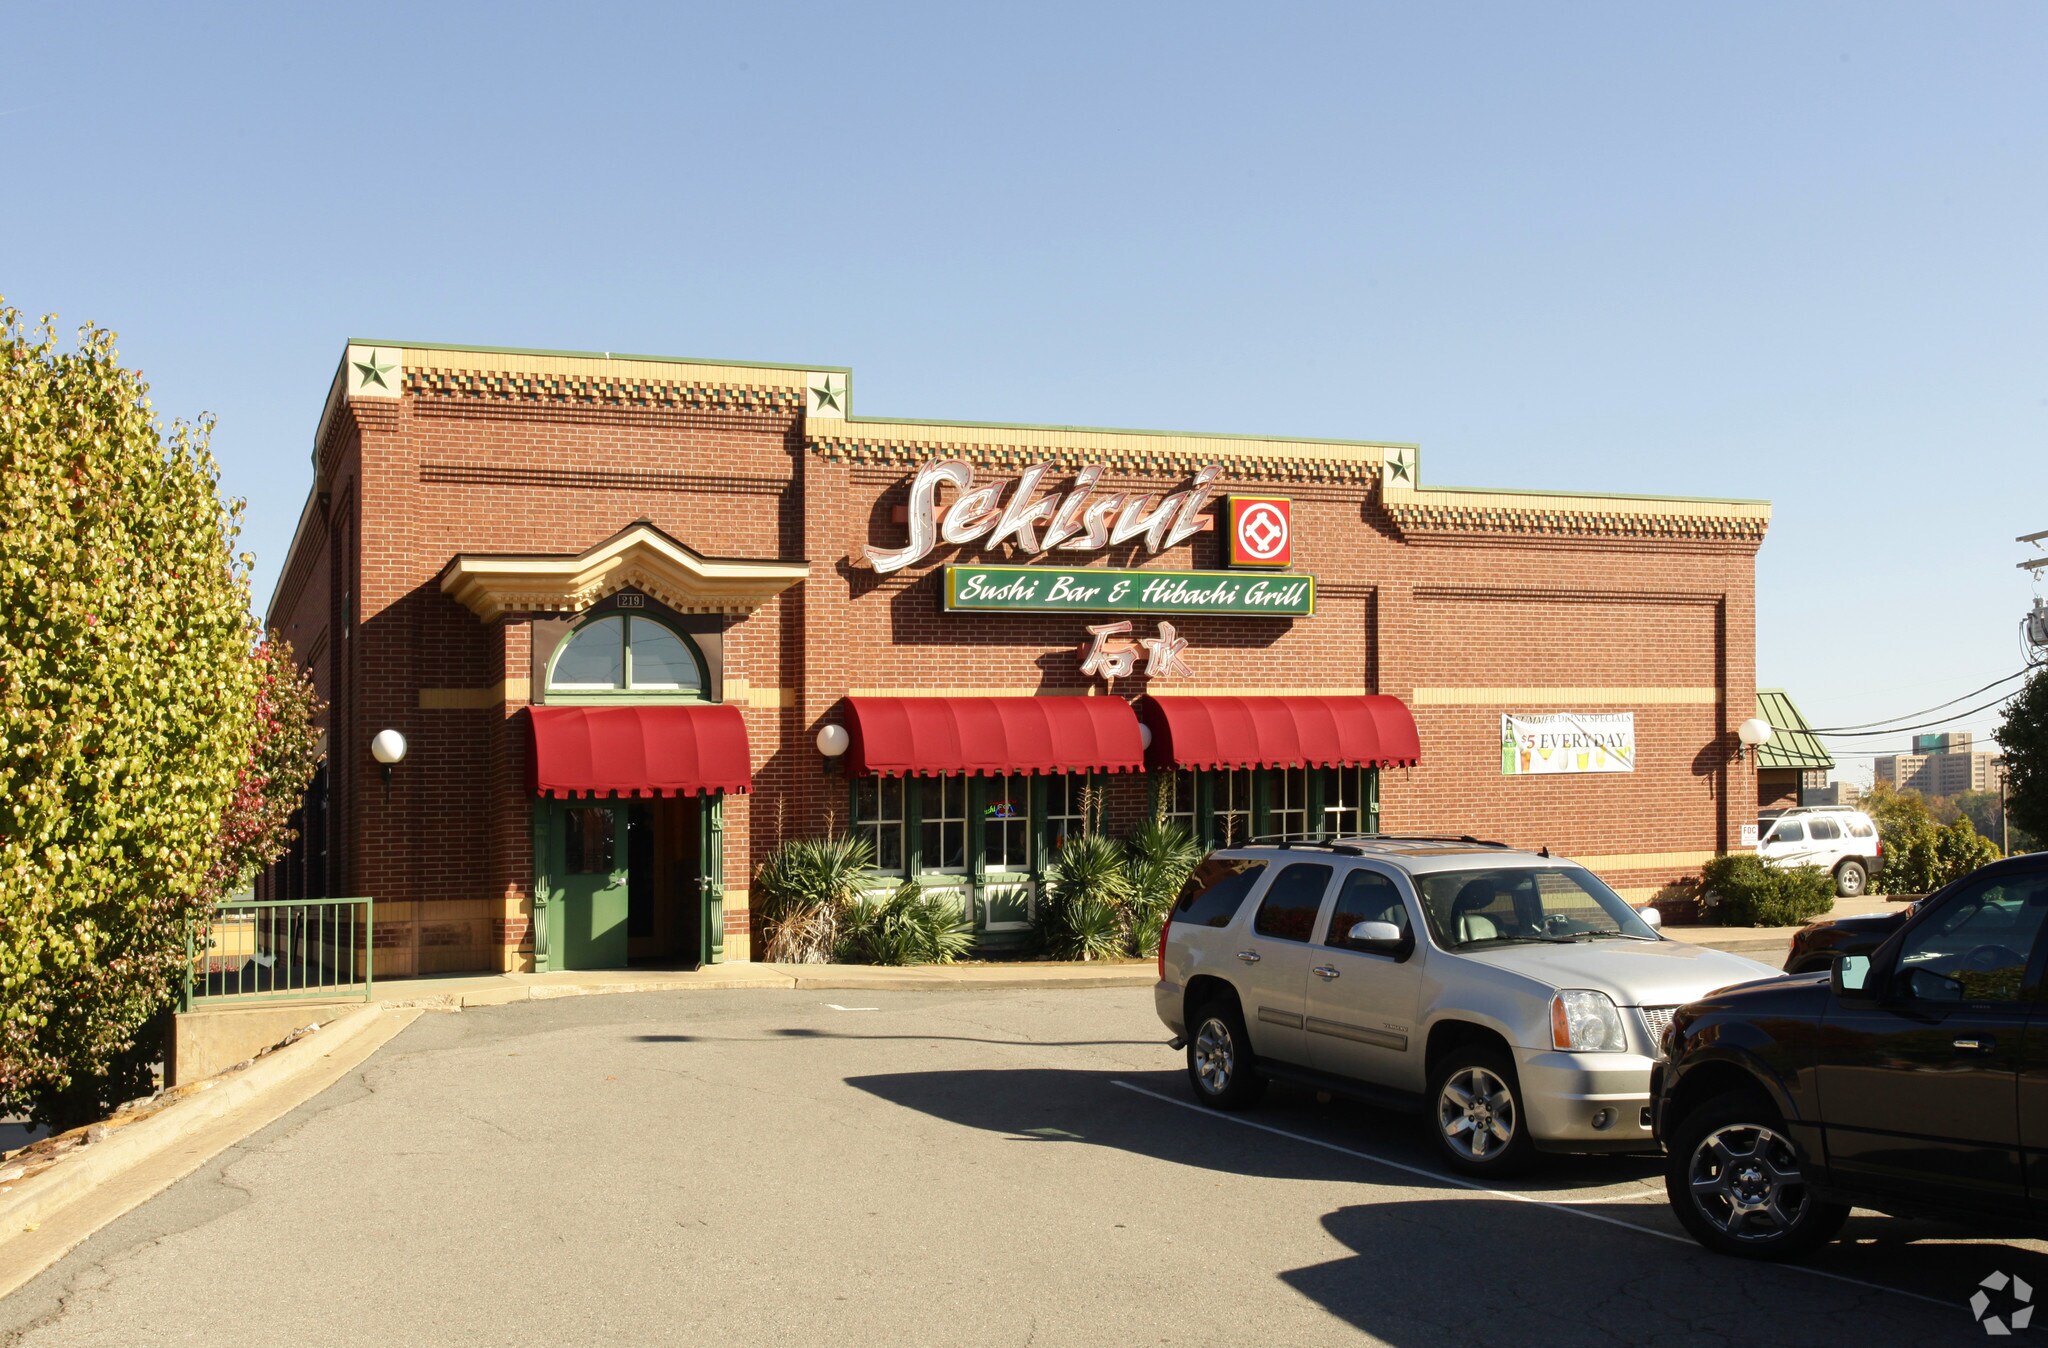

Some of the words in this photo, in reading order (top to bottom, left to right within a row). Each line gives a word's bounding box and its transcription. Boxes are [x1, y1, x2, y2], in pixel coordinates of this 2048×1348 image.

[863, 456, 1223, 574] Sekisui
[959, 574, 1039, 601] Sushi
[1045, 576, 1100, 602] Bar
[1107, 580, 1131, 603] &
[1142, 578, 1240, 605] Hibachi
[1244, 581, 1308, 607] Grill
[621, 595, 640, 606] 219
[1589, 713, 1632, 723] SPECIALS
[1521, 734, 1536, 749] $5
[1540, 733, 1626, 749] EVERYDAY
